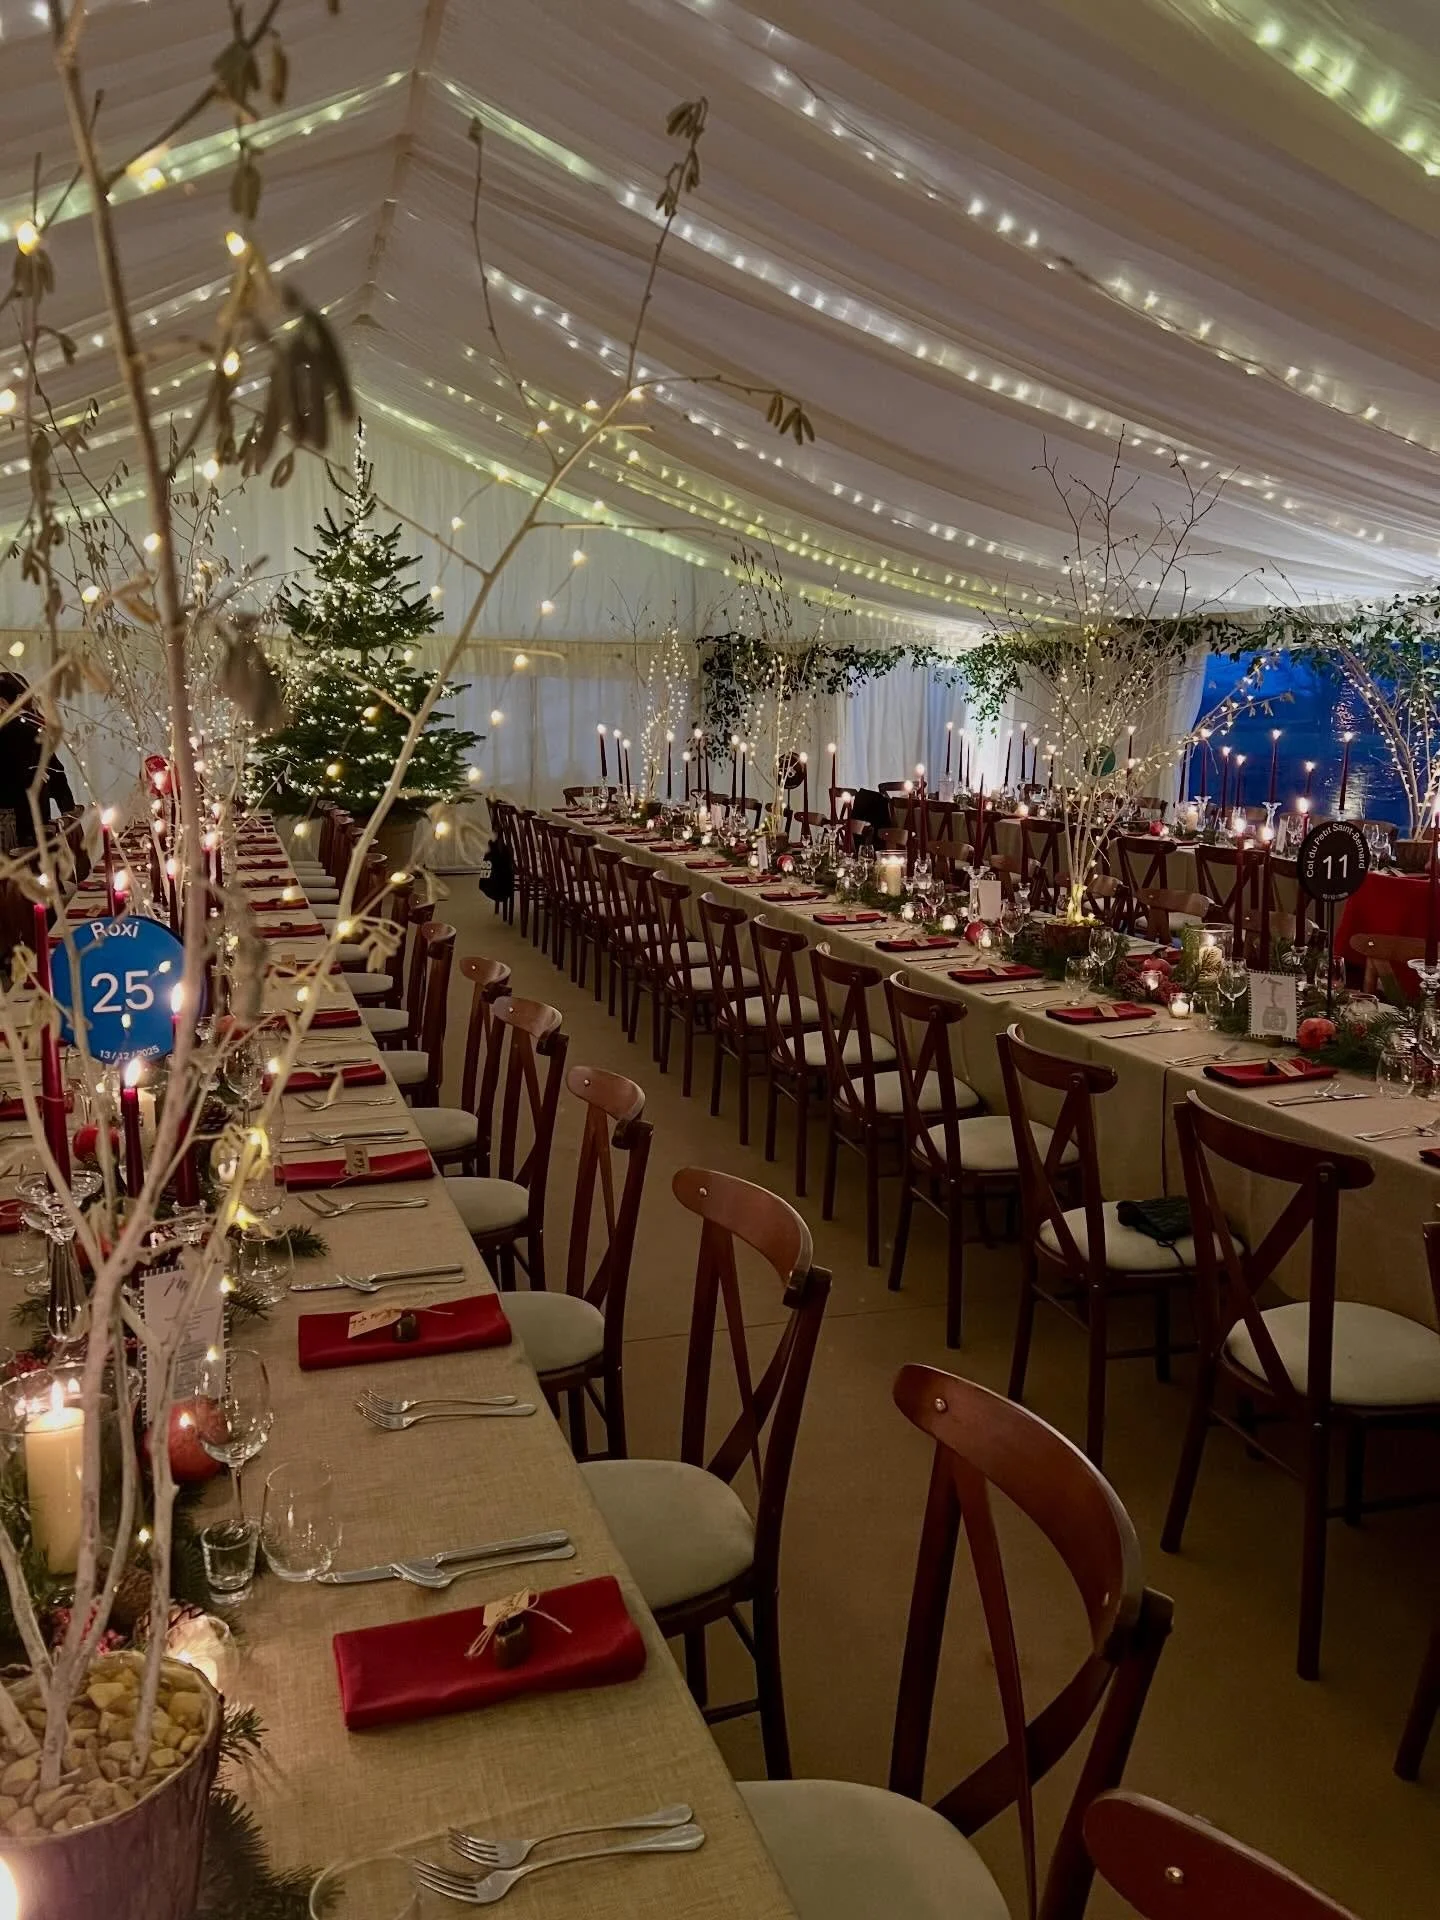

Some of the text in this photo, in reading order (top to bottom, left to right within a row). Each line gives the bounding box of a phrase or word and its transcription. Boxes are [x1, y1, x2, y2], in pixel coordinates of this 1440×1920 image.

[1306, 823, 1366, 878] Col du Petit Saint-Bernard
[1322, 854, 1348, 880] 11
[90, 921, 140, 939] Roxi
[91, 970, 154, 1013] 25
